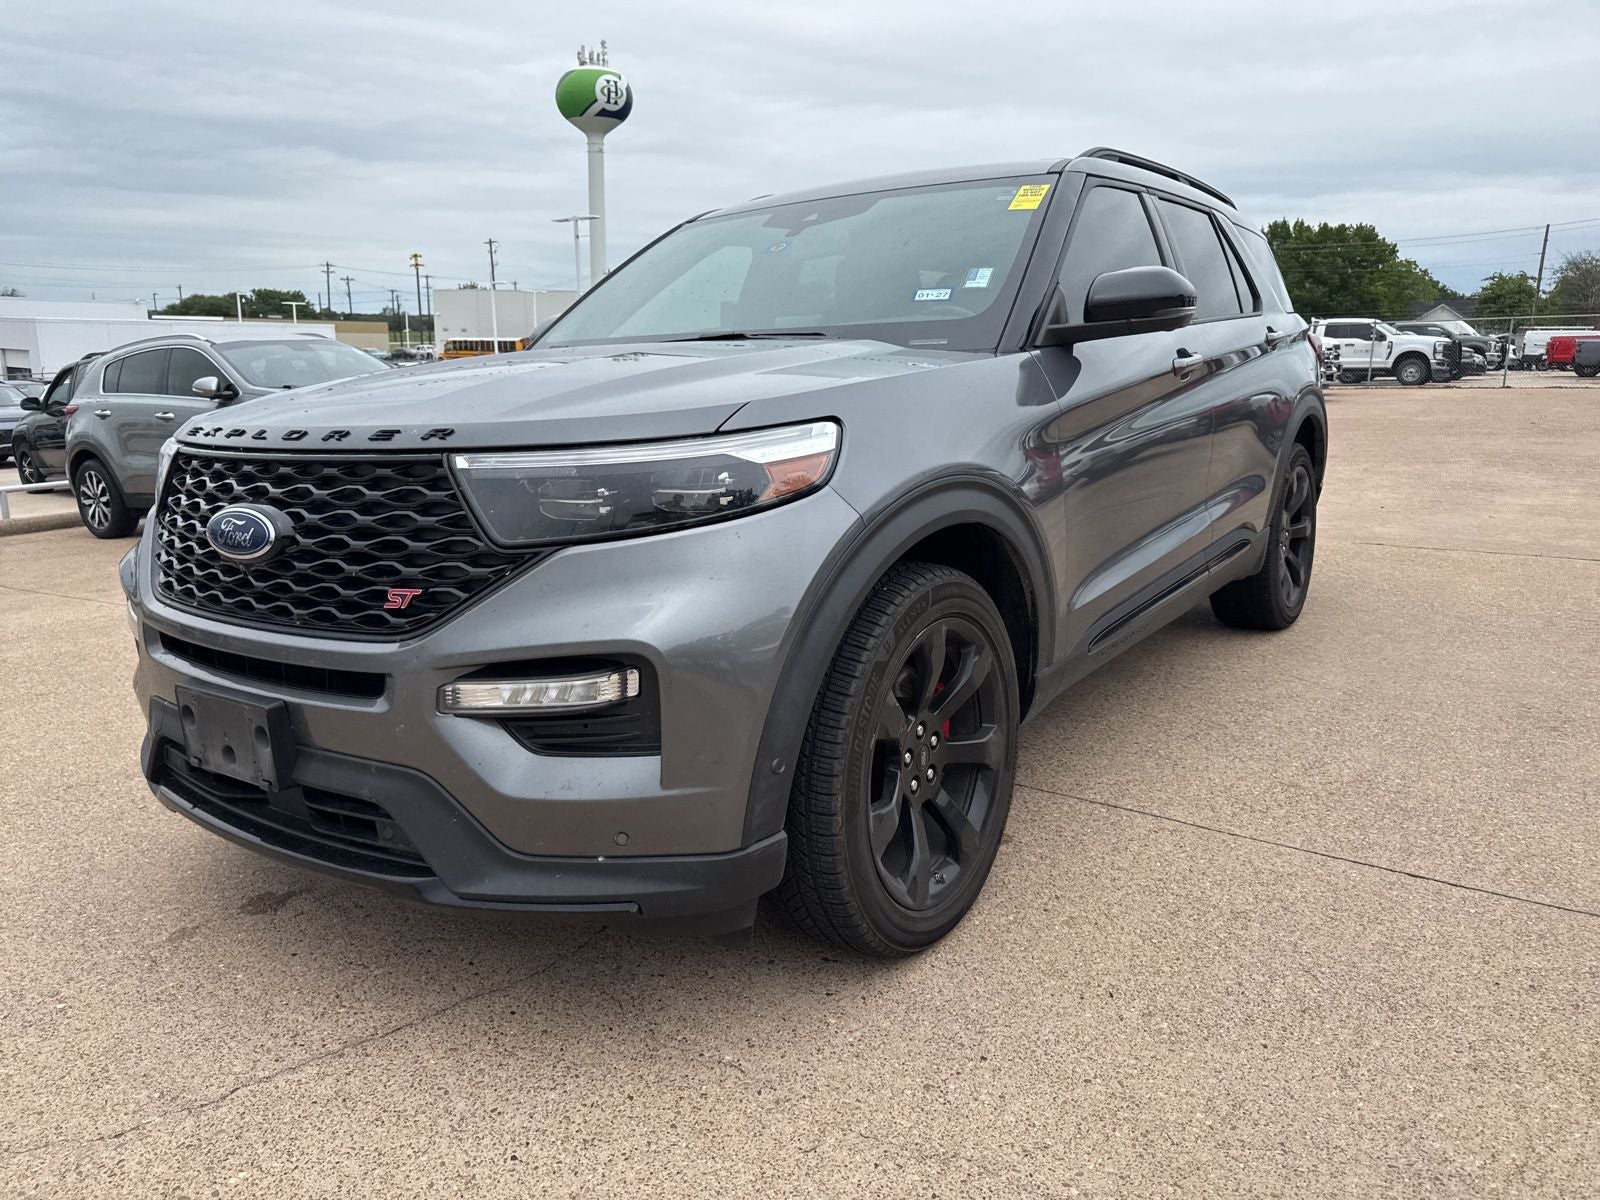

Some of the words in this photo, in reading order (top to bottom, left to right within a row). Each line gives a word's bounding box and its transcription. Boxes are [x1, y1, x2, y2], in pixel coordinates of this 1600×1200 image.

[186, 426, 455, 442] EXPLORER
[217, 517, 253, 548] Ford
[384, 588, 423, 609] ST
